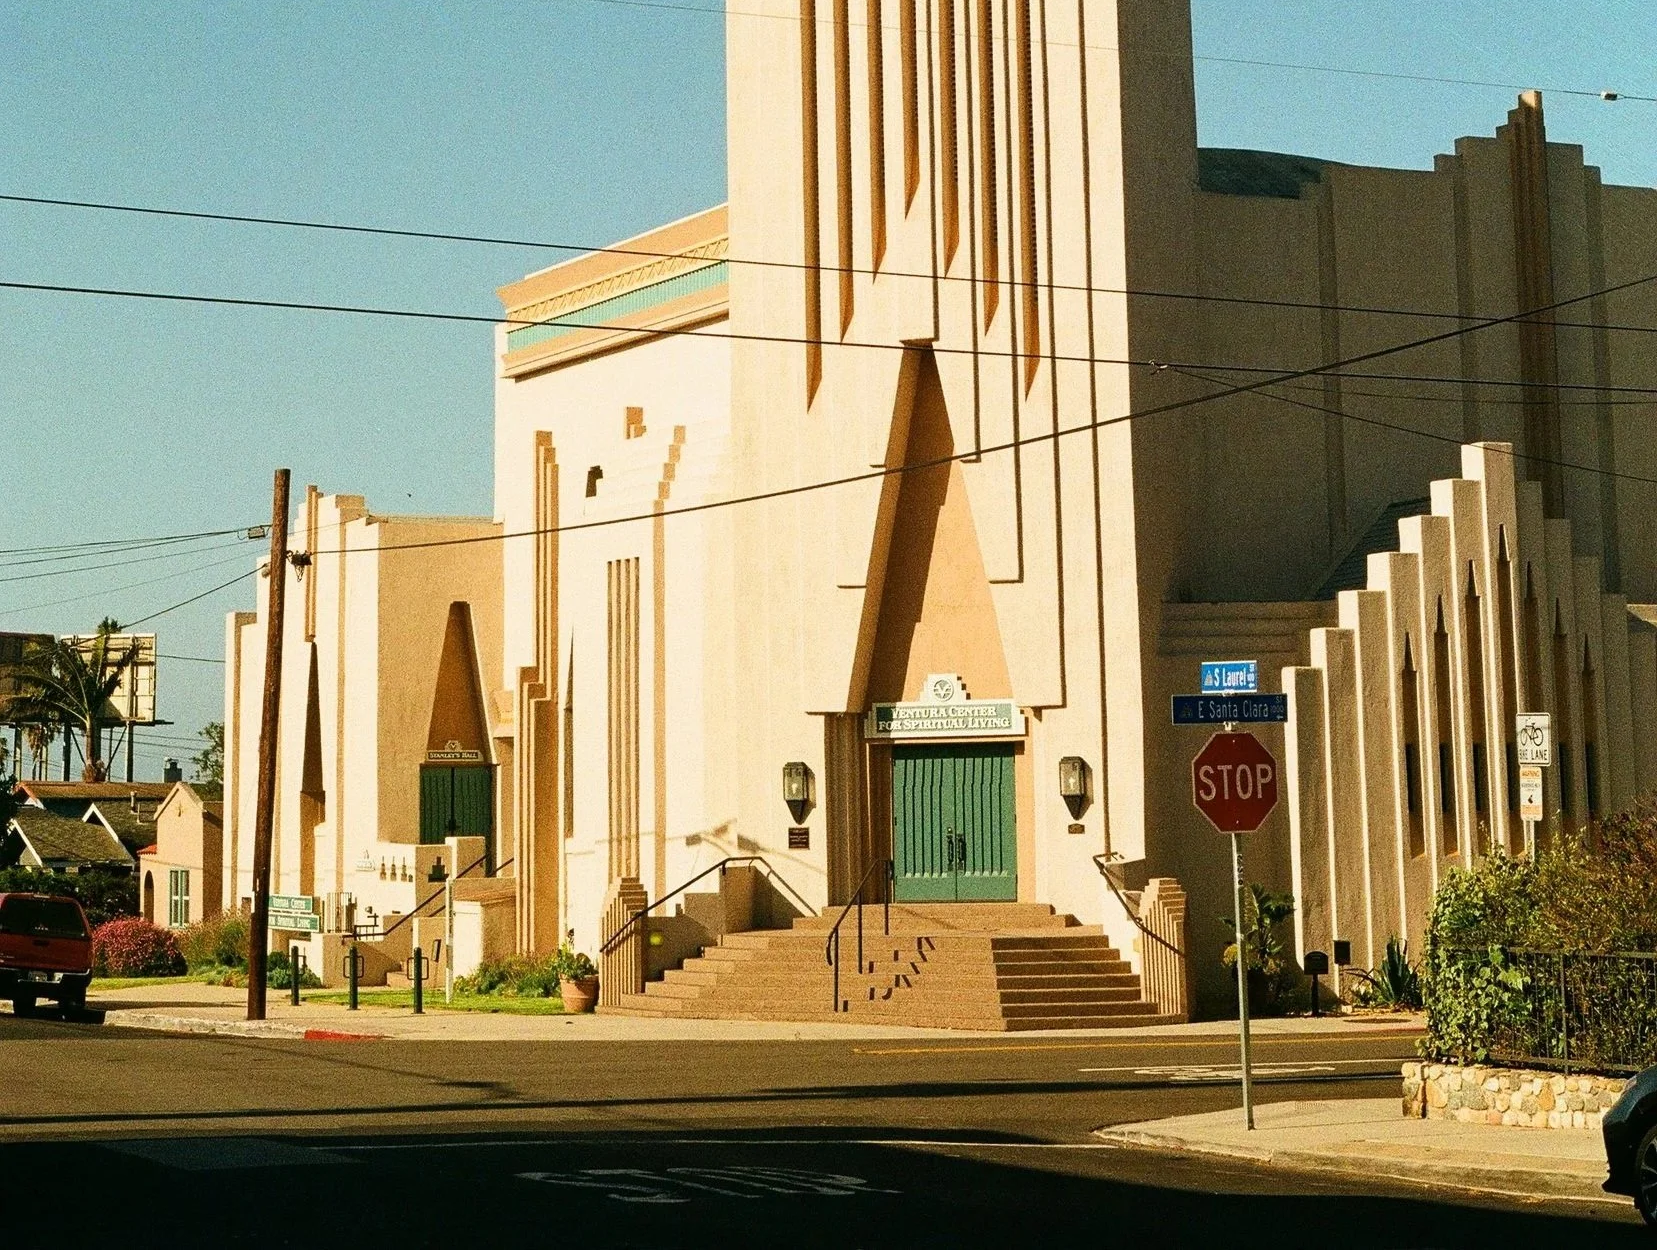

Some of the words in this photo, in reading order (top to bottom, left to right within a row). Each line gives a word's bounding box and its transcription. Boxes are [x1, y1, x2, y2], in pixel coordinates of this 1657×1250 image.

[1214, 667, 1220, 687] S
[1222, 667, 1247, 687] Laurel
[891, 707, 948, 719] VENTURA
[949, 706, 997, 717] CENTER
[1198, 701, 1204, 719] E
[1209, 700, 1238, 719] Santa
[1242, 700, 1269, 718] Clara
[878, 720, 902, 731] FOR
[903, 718, 967, 730] SPIRITUAL
[968, 717, 1010, 728] LIVING
[1530, 749, 1548, 761] LANE
[1199, 763, 1273, 801] STOP
